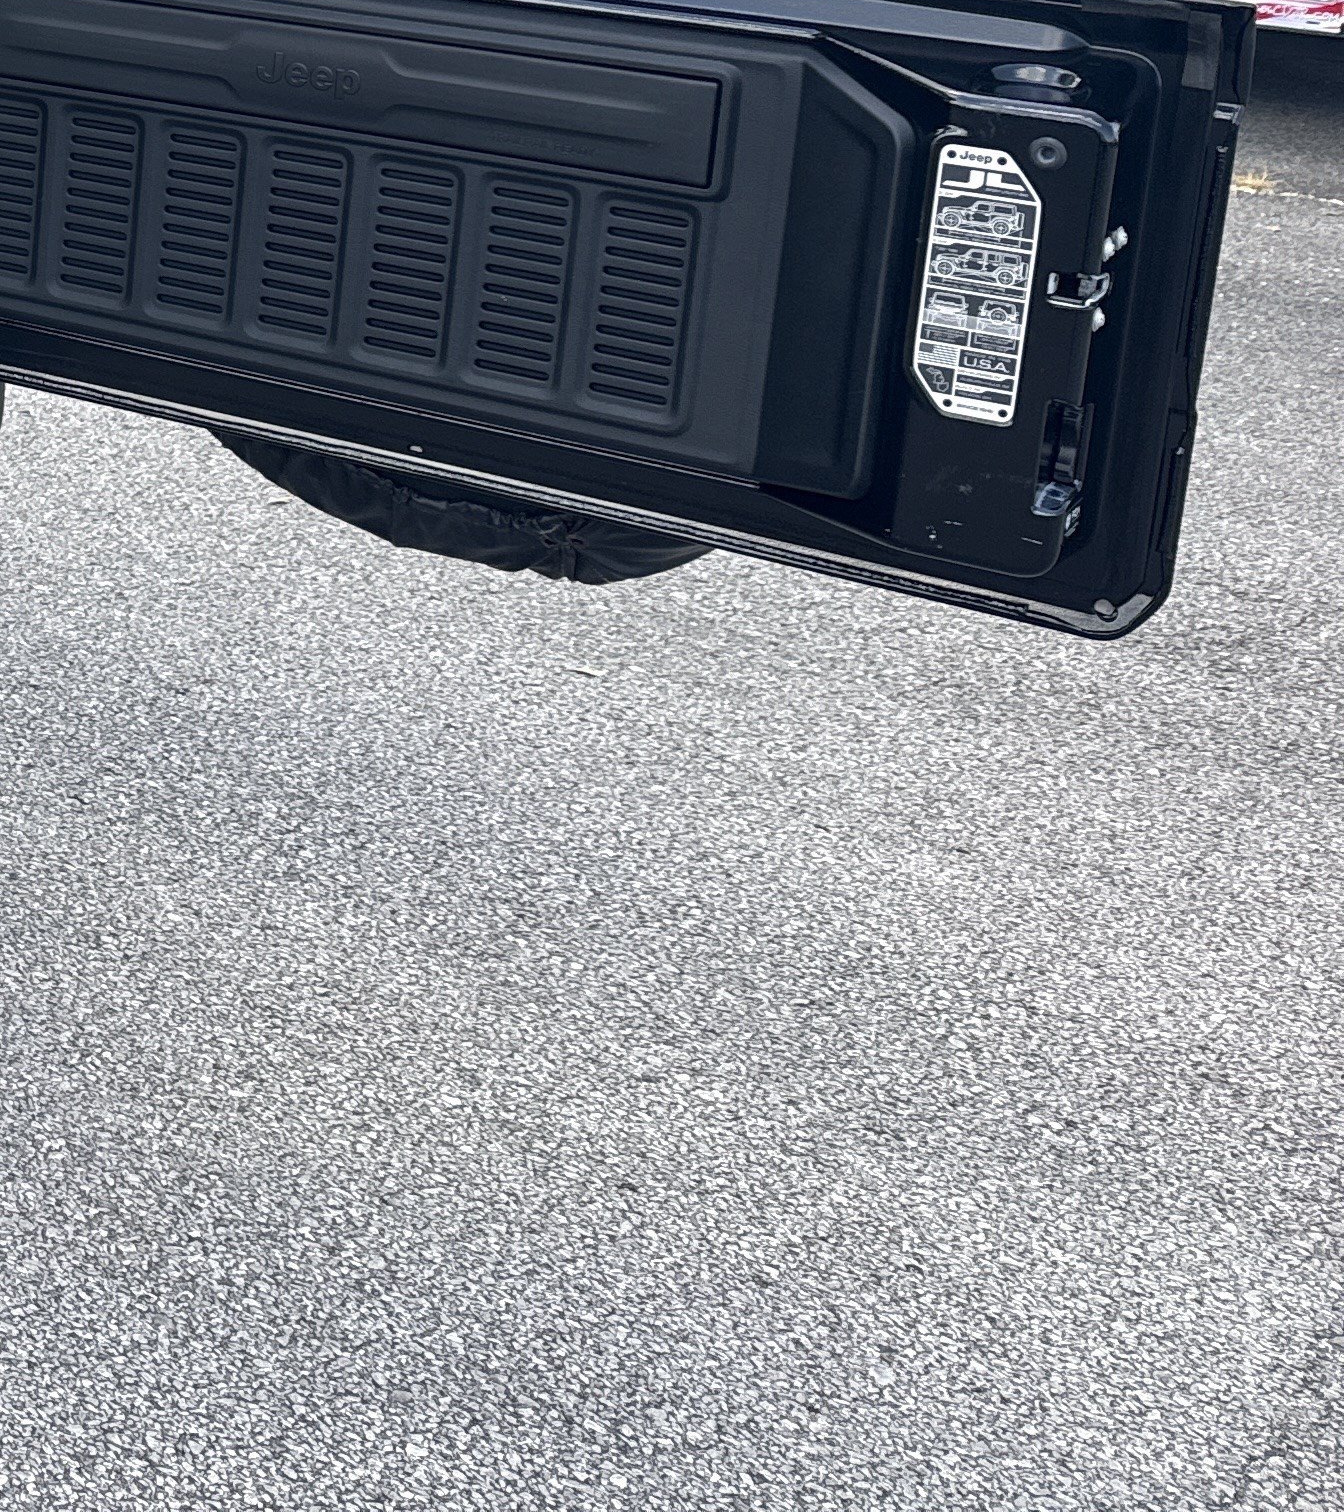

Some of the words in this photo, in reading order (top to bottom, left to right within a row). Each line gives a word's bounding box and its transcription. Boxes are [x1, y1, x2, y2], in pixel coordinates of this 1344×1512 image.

[255, 50, 362, 101] Jeep
[959, 150, 993, 165] Jeep
[942, 169, 1026, 192] JL
